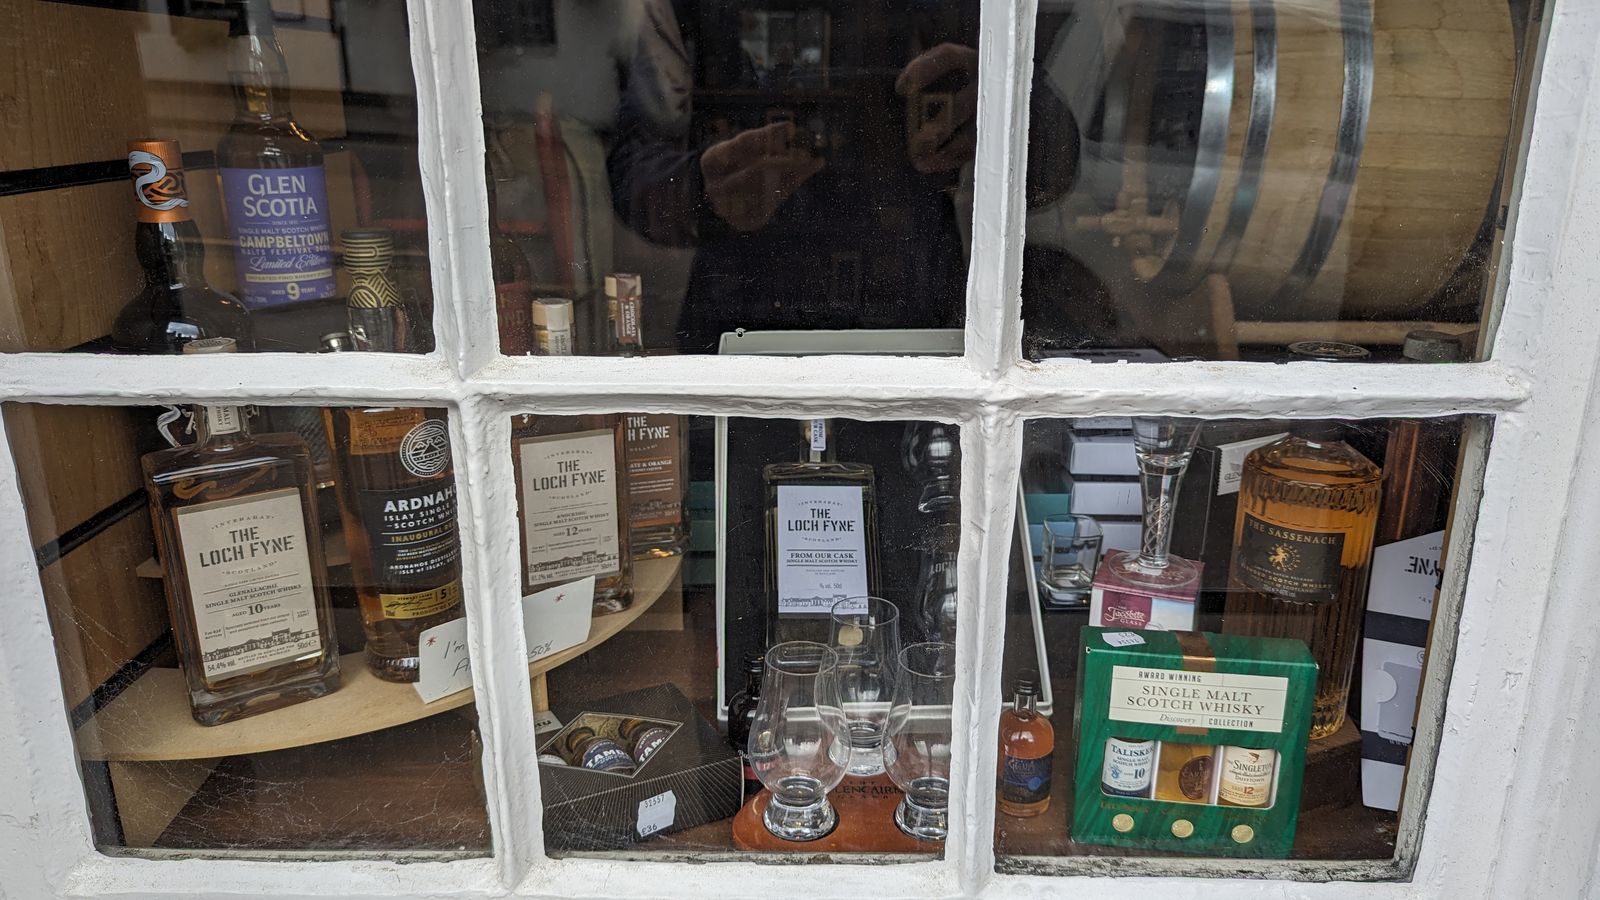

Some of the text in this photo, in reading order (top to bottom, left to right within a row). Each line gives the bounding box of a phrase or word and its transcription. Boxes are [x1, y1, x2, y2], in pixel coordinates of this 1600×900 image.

[248, 174, 306, 196] GLEN
[243, 196, 318, 217] SCOTIA
[282, 226, 309, 234] SCOTCH
[240, 231, 329, 249] CAMPBELTOWN
[271, 247, 312, 256] FESTIVAL
[249, 256, 293, 271] Limited
[287, 282, 301, 300] 9
[627, 416, 648, 428] THE
[627, 425, 671, 442] H FYNE
[557, 459, 581, 474] THE
[533, 469, 607, 491] LOCH FYNE
[384, 513, 414, 521] ISLAY
[419, 502, 450, 518] SINGLE
[810, 508, 831, 519] THE
[394, 510, 454, 529] SCOTCH WHI
[788, 519, 856, 532] LOCH FYNE
[229, 526, 260, 543] THE
[391, 527, 442, 543] INAUGURAL
[566, 526, 579, 537] 12
[1249, 519, 1336, 545] THE SASSENACH
[199, 535, 295, 568] LOCH FYNE
[389, 561, 428, 570] ARDNAHOE
[1268, 575, 1299, 586] SCOTCH
[205, 599, 229, 609] SINGLE
[230, 596, 249, 604] MALT
[249, 589, 276, 600] SCOTCH
[440, 588, 447, 600] 5
[247, 603, 264, 616] 10
[1120, 618, 1142, 626] GLASS
[207, 661, 227, 672] 54.4%
[1138, 671, 1202, 683] AWARD WINNING
[1142, 685, 1252, 703] SINGLE MALT
[1127, 696, 1265, 715] SCOTCH WHISKY
[1208, 718, 1254, 728] COLLECTION
[638, 737, 665, 763] TAM
[1134, 768, 1145, 779] 10
[1244, 786, 1255, 795] 12
